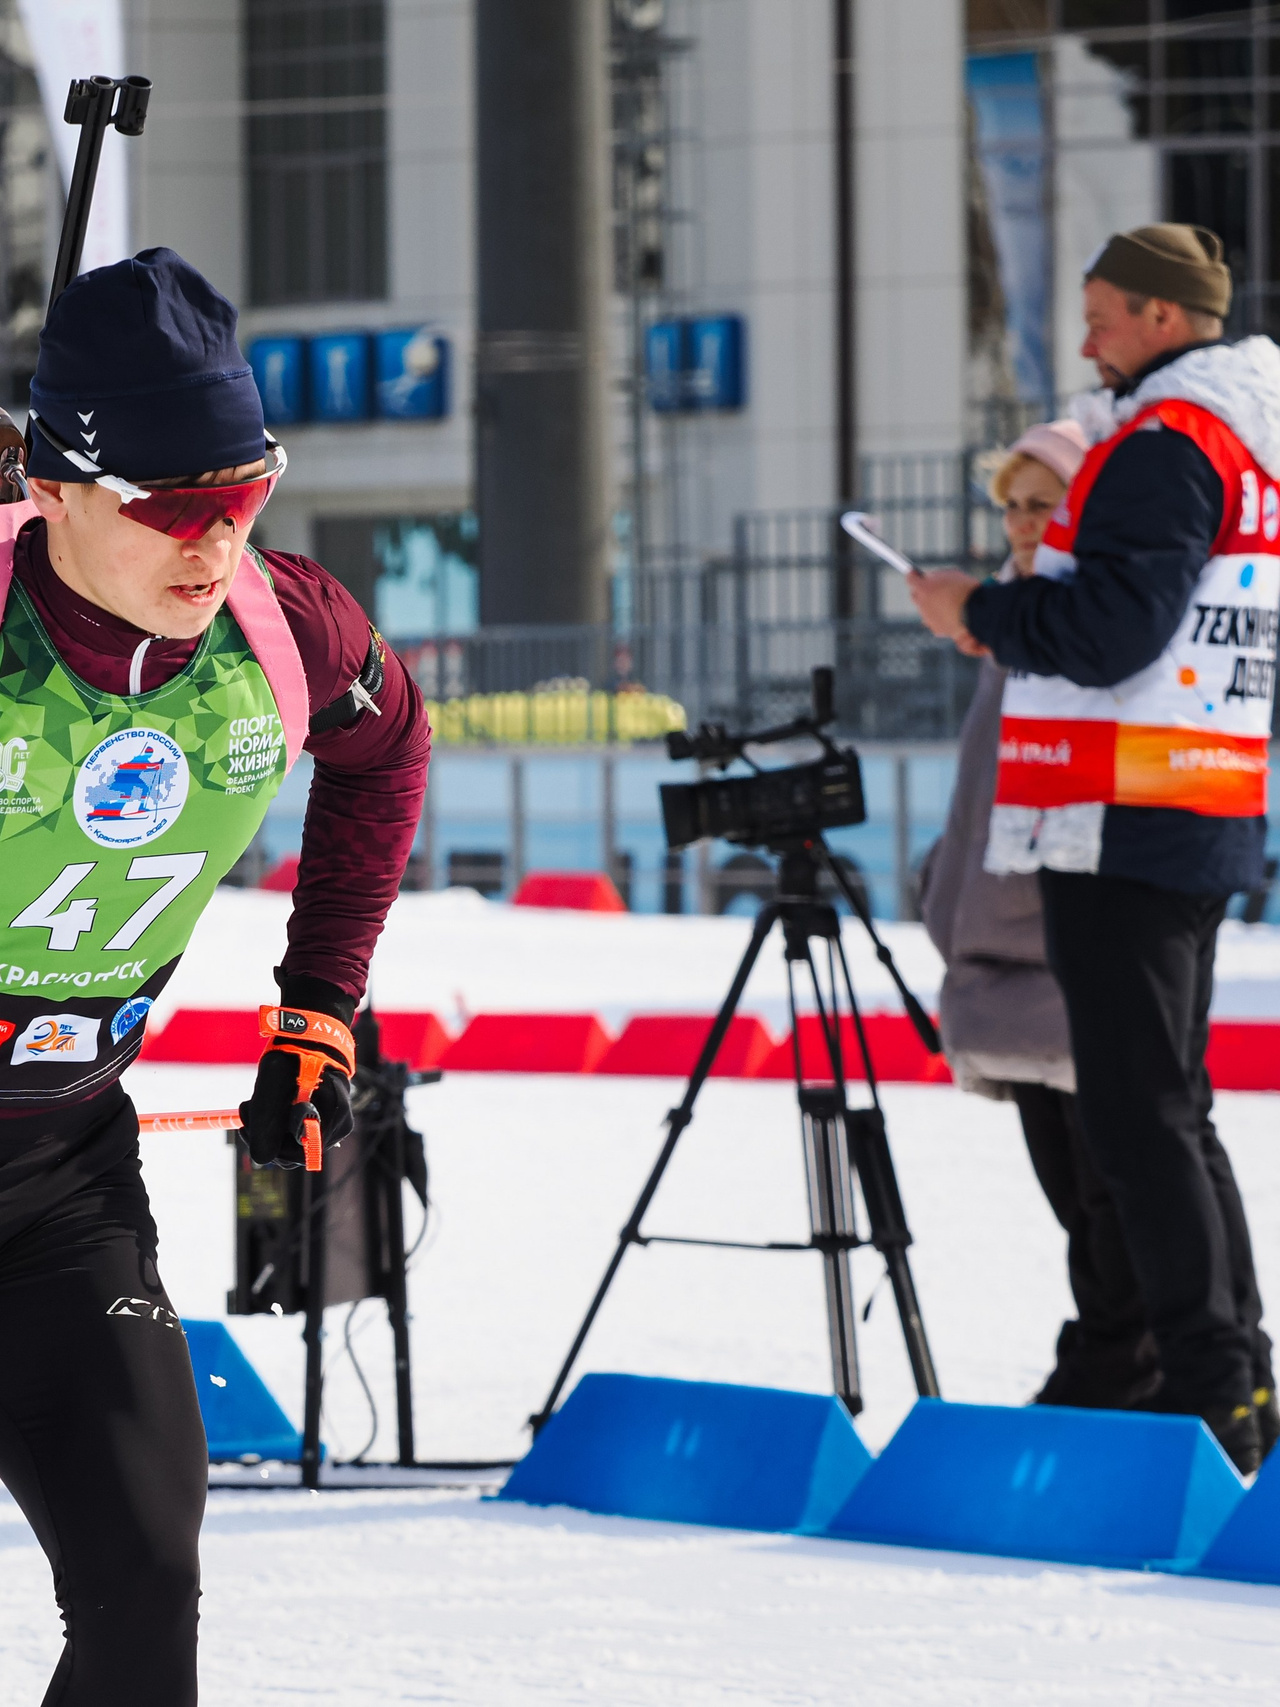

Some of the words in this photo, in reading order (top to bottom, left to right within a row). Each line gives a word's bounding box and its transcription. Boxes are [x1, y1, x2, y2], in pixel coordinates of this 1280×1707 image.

[85, 730, 145, 770] ПЕРВЕНСТВО
[146, 731, 182, 760] РОССИИ
[228, 731, 284, 756] НОРМА
[14, 751, 31, 760] ЛЕТ
[227, 748, 280, 775] ЖИЗНИ
[226, 763, 277, 785] ФЕДЕРАЛЬНЫЙ
[225, 783, 256, 796] ПРОЕКТ
[10, 797, 41, 806] СПОРТА
[93, 828, 142, 845] Красноярск
[145, 818, 168, 837] 2023
[8, 850, 209, 952] 47
[59, 1023, 73, 1031] ЛЕТ
